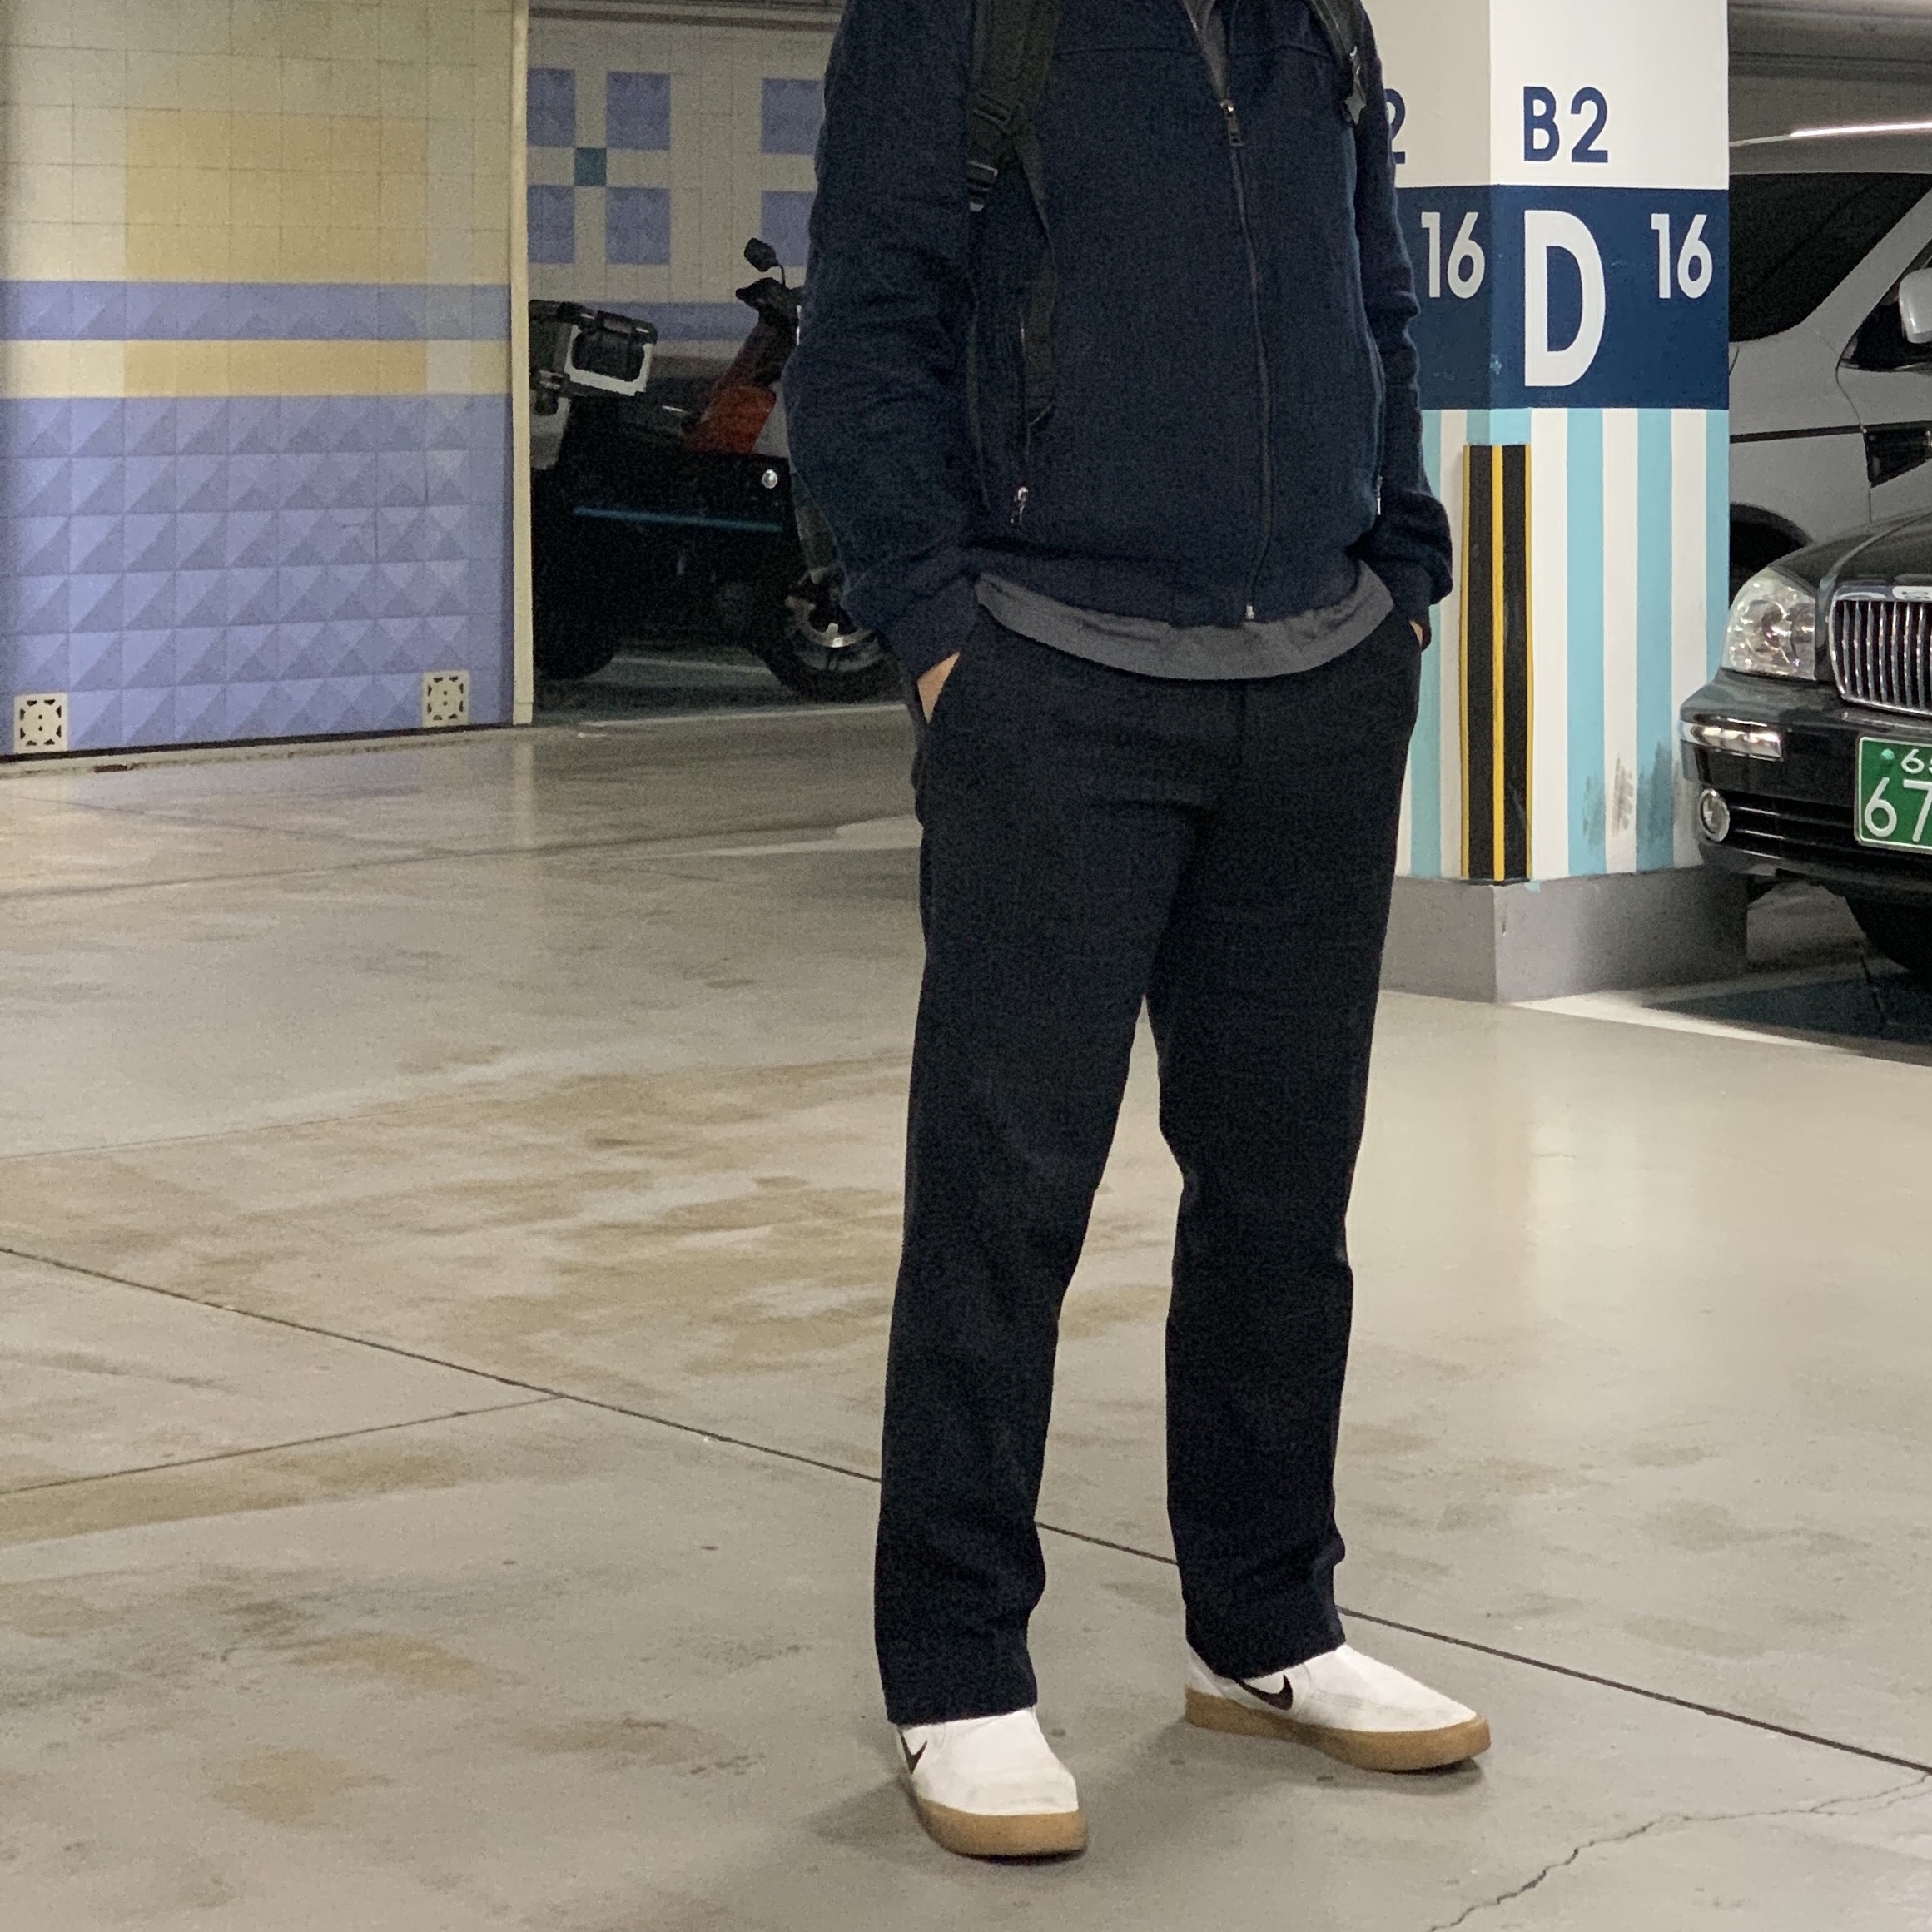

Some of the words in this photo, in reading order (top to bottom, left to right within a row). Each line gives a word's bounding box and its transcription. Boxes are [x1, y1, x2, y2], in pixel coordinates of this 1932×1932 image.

[1384, 88, 1405, 165] 2
[1523, 86, 1608, 163] B2
[1421, 211, 1485, 299] 16
[1524, 210, 1607, 387] D
[1651, 213, 1713, 299] 16
[1900, 748, 1932, 774] 6
[1865, 777, 1932, 842] 67
